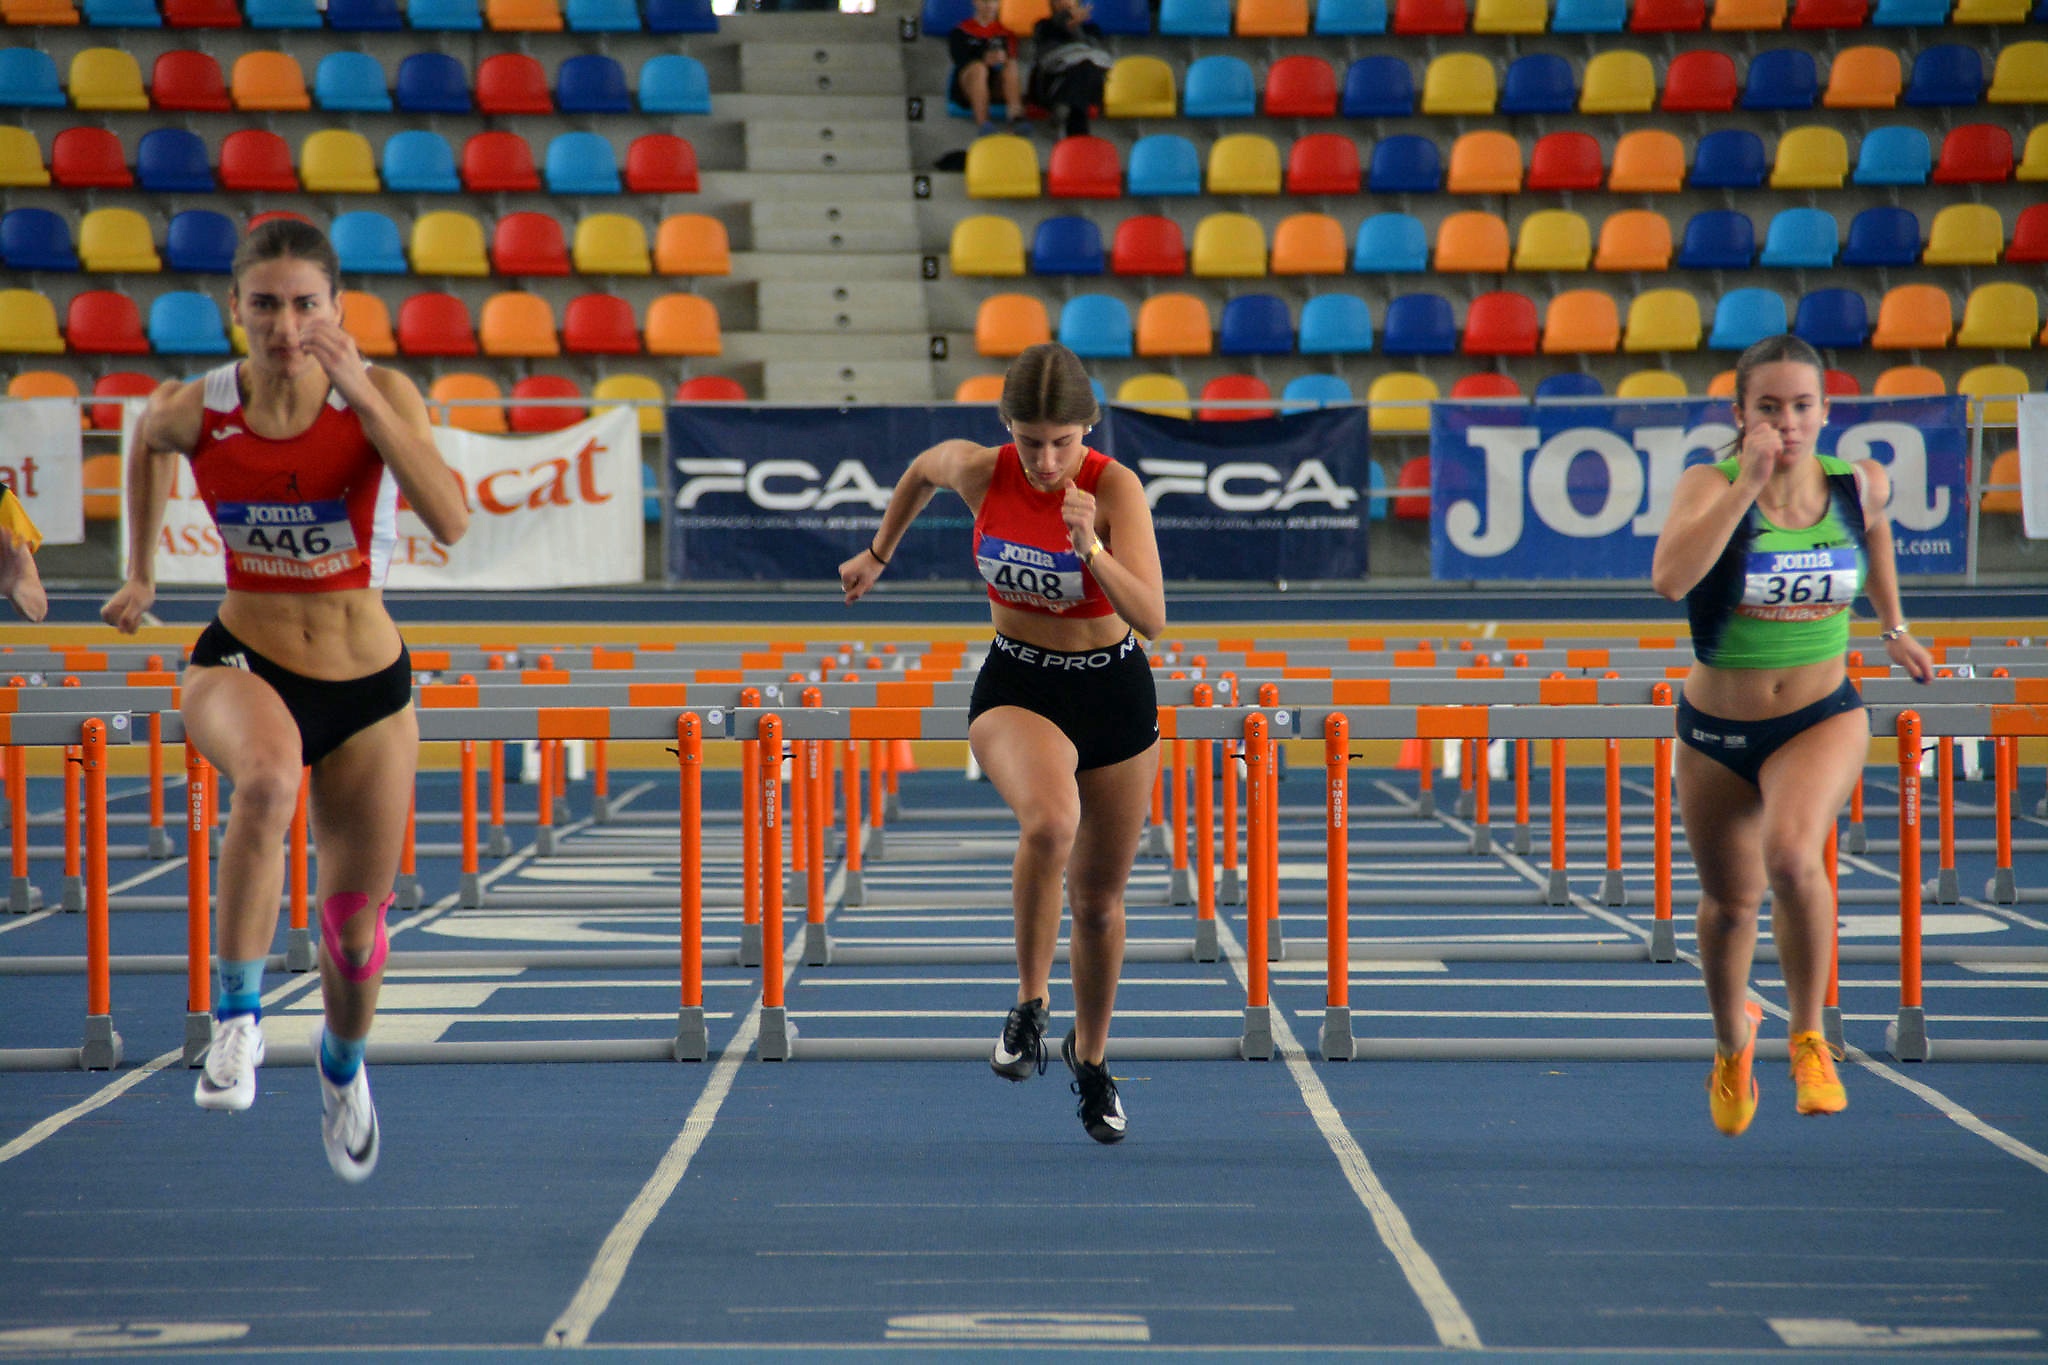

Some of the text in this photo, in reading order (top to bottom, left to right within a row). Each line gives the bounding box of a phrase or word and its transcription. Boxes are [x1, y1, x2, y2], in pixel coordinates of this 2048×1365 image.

[675, 458, 894, 511] FCA
[1137, 458, 1359, 511] FCA
[247, 527, 332, 558] 446
[242, 552, 350, 580] mutuacat
[994, 565, 1064, 600] 408
[1763, 573, 1834, 605] 361
[1042, 652, 1111, 670] PRO
